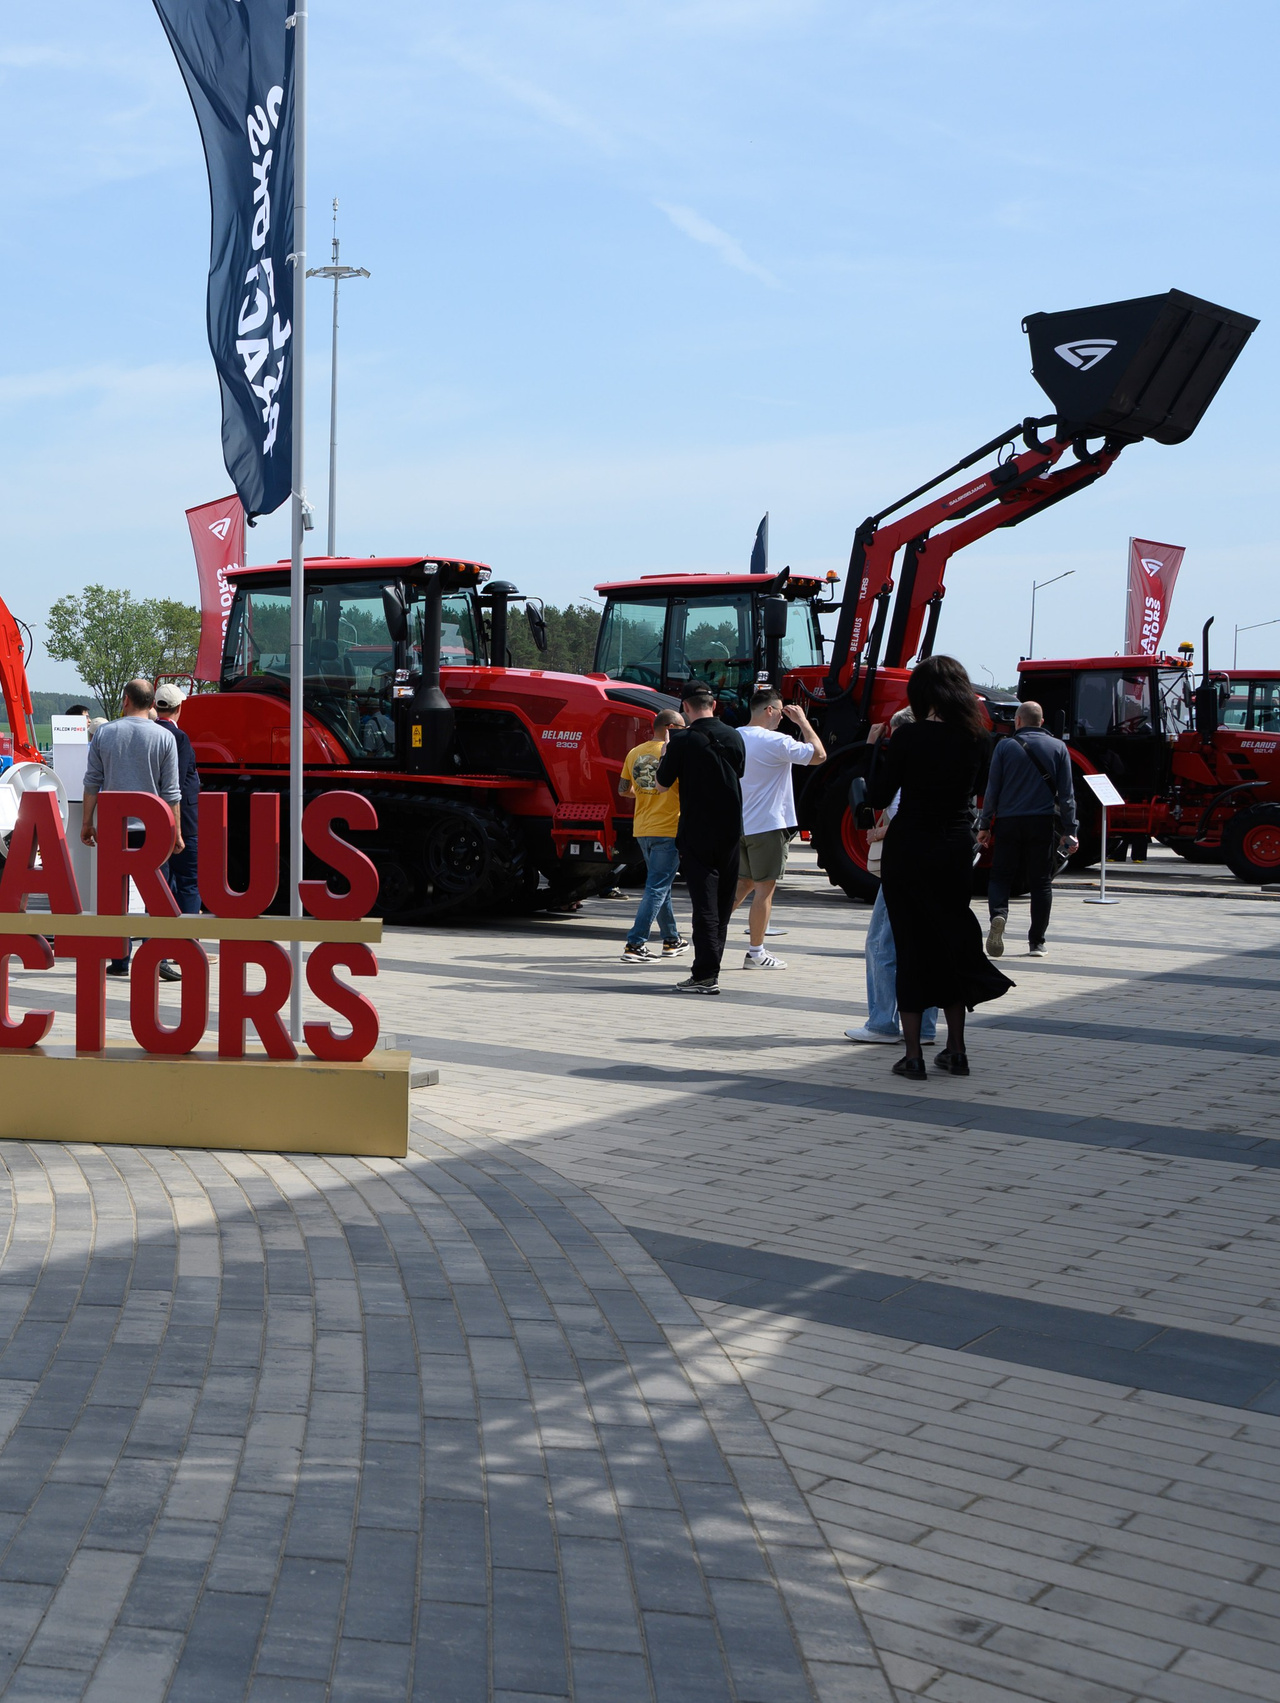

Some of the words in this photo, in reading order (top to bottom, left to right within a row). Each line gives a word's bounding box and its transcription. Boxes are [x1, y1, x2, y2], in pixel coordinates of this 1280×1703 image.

[850, 617, 863, 652] BELARUS
[1140, 596, 1154, 655] ARUS
[1146, 599, 1161, 655] CTORS
[541, 730, 583, 741] BELARUS
[556, 741, 578, 749] 2303
[1240, 740, 1277, 749] BELARUS
